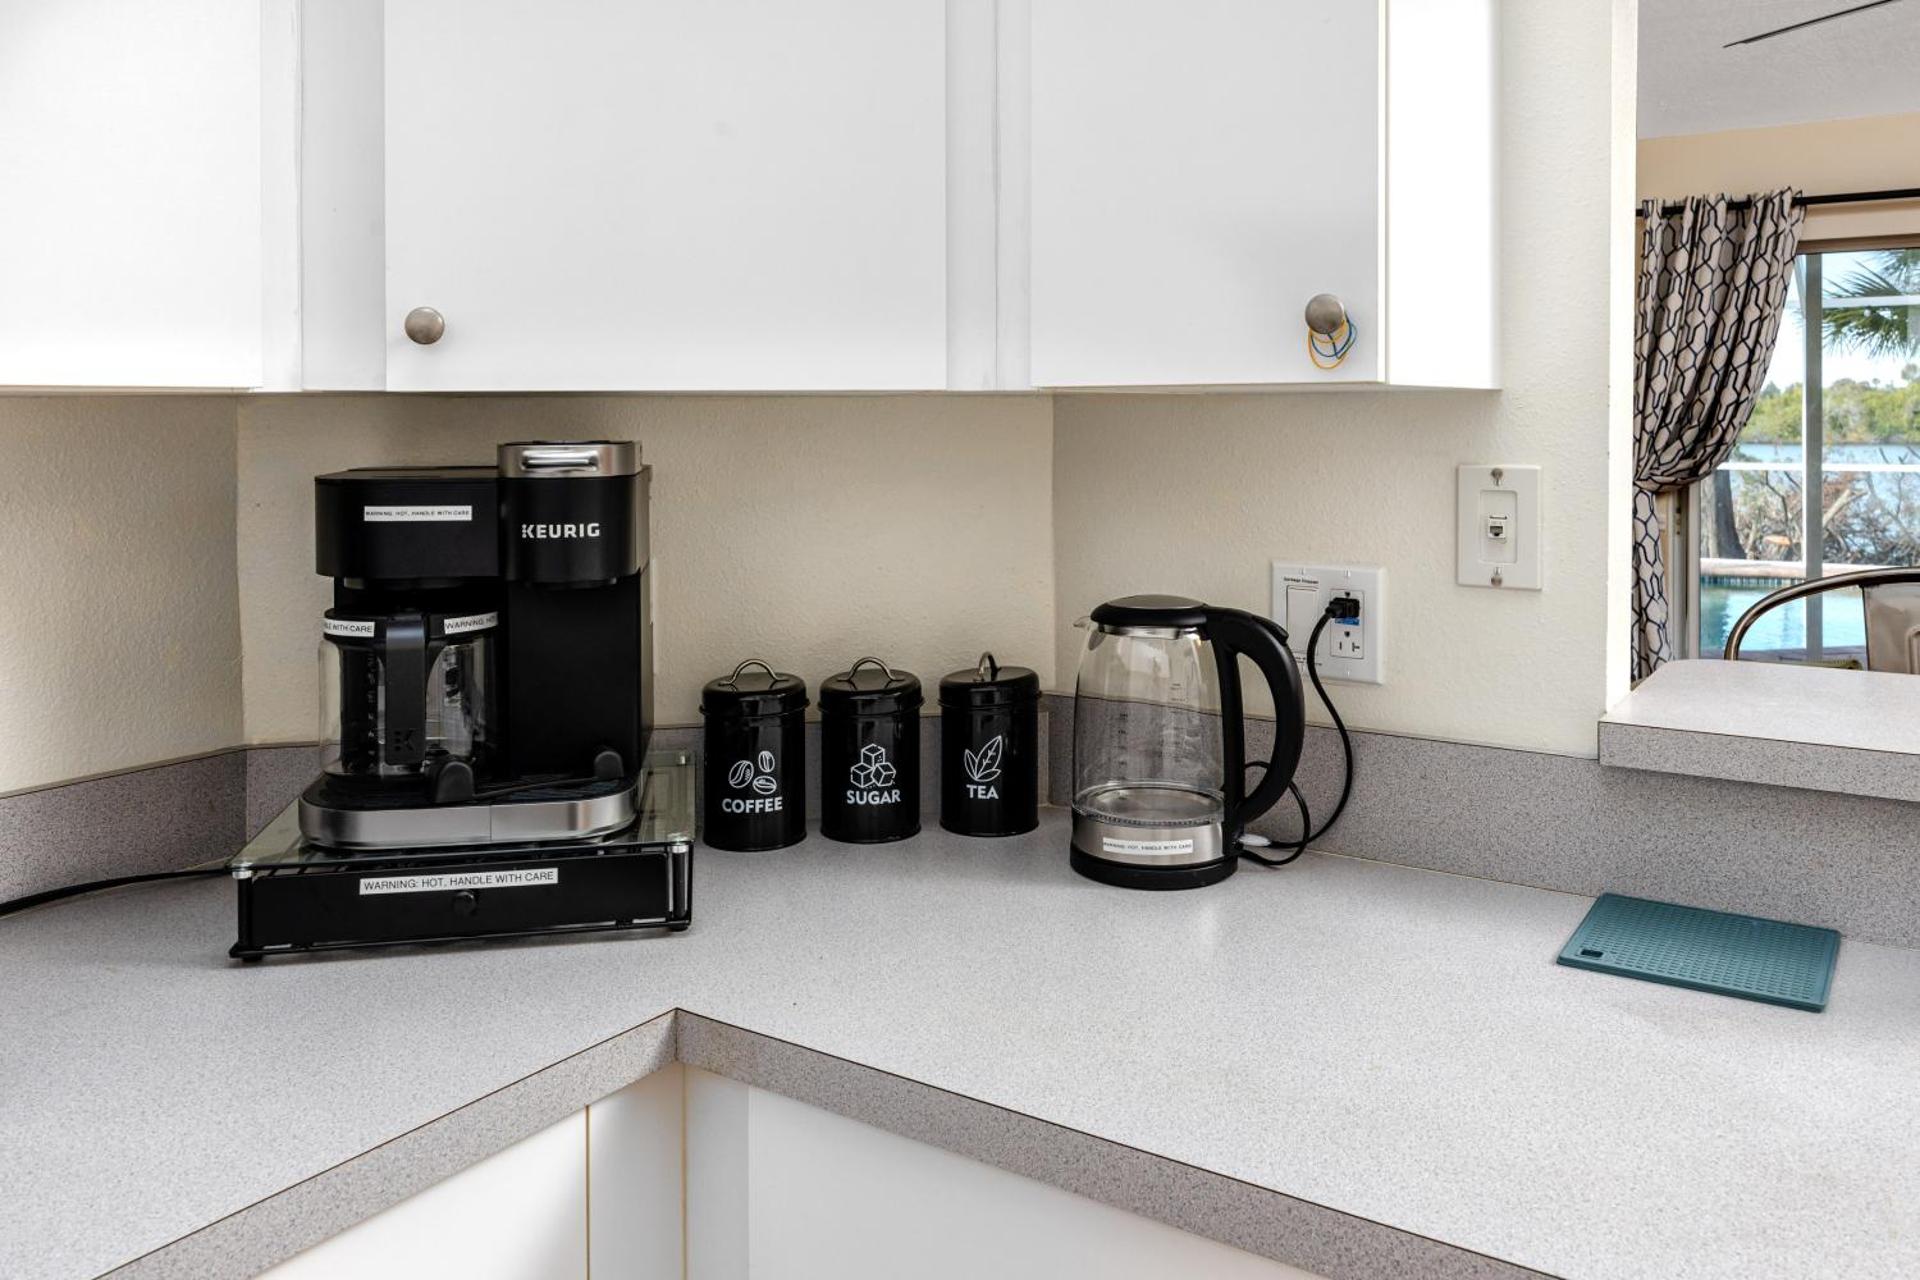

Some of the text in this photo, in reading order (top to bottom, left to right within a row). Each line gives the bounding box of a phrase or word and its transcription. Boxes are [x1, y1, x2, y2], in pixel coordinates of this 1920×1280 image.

[521, 522, 600, 539] KEURIG
[350, 625, 373, 633] CARE
[847, 790, 901, 805] SUGAR
[966, 784, 999, 799] TEA
[722, 796, 783, 813] COFFEE
[364, 879, 418, 891] WARNING:
[450, 874, 493, 886] HANDLE
[494, 873, 522, 884] WITH
[524, 870, 554, 881] CARE
